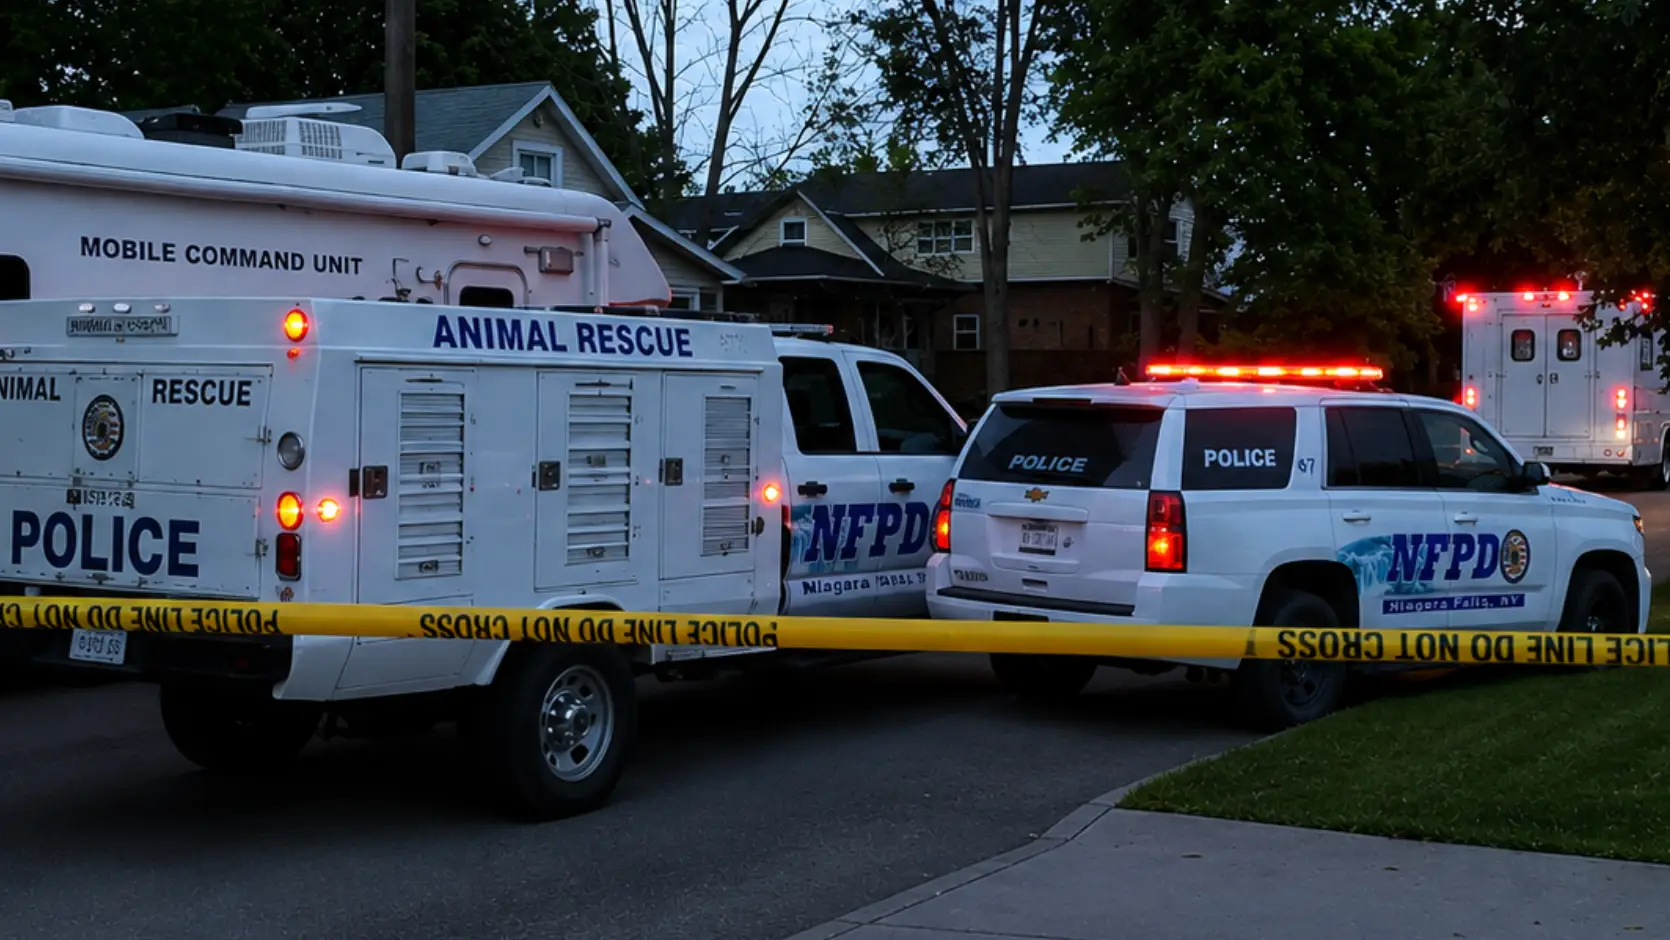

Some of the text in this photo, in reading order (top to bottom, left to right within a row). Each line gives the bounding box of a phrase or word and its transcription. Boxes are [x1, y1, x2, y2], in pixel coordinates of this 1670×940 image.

[80, 236, 363, 275] MOBILE COMMAND UNIT
[433, 315, 568, 352] ANIMAL
[576, 322, 693, 357] RESCUE
[152, 379, 252, 406] RESCUE
[1008, 455, 1088, 472] POLICE
[1204, 448, 1277, 468] POLICE
[12, 509, 200, 577] POLICE
[804, 502, 930, 562] NFPD
[1387, 533, 1500, 581] NFPD
[87, 604, 124, 630] DO
[131, 606, 184, 632] LINE
[191, 607, 283, 634] POLICE
[419, 612, 778, 647] POLICE LINE DO NOT CROSS
[1277, 630, 1384, 660] CROSS
[1395, 632, 1459, 661] NOT
[1471, 633, 1515, 662] DO
[1527, 635, 1593, 663] LINE
